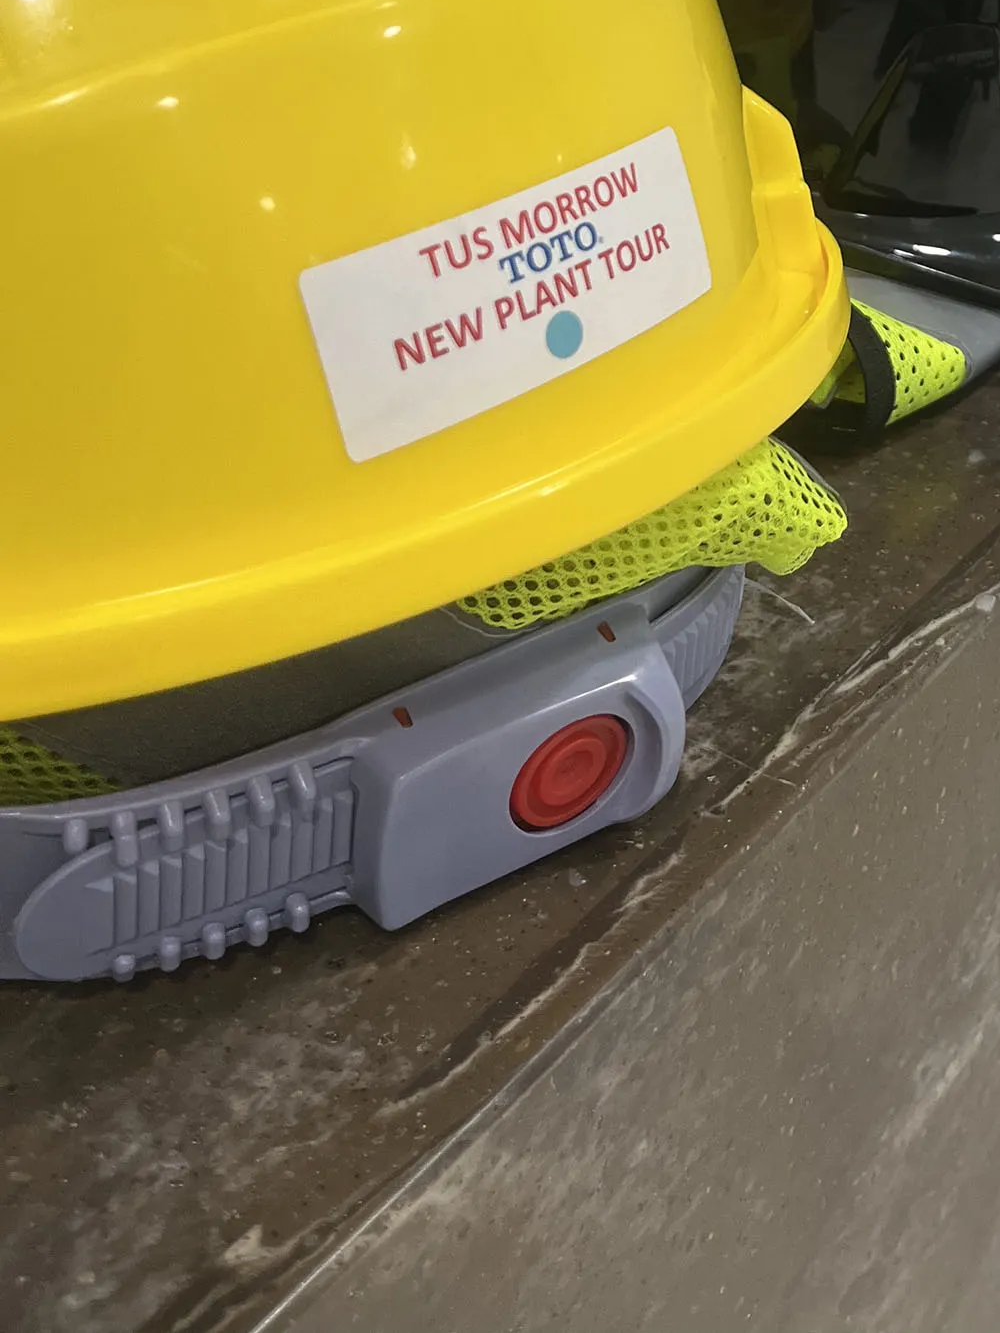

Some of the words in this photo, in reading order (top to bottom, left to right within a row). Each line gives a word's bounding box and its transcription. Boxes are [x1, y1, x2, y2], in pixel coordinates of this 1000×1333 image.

[419, 227, 494, 278] TUS
[498, 163, 638, 250] MORROW
[393, 308, 484, 371] NEW
[494, 258, 592, 330] PLANT
[598, 223, 670, 279] TOUR
